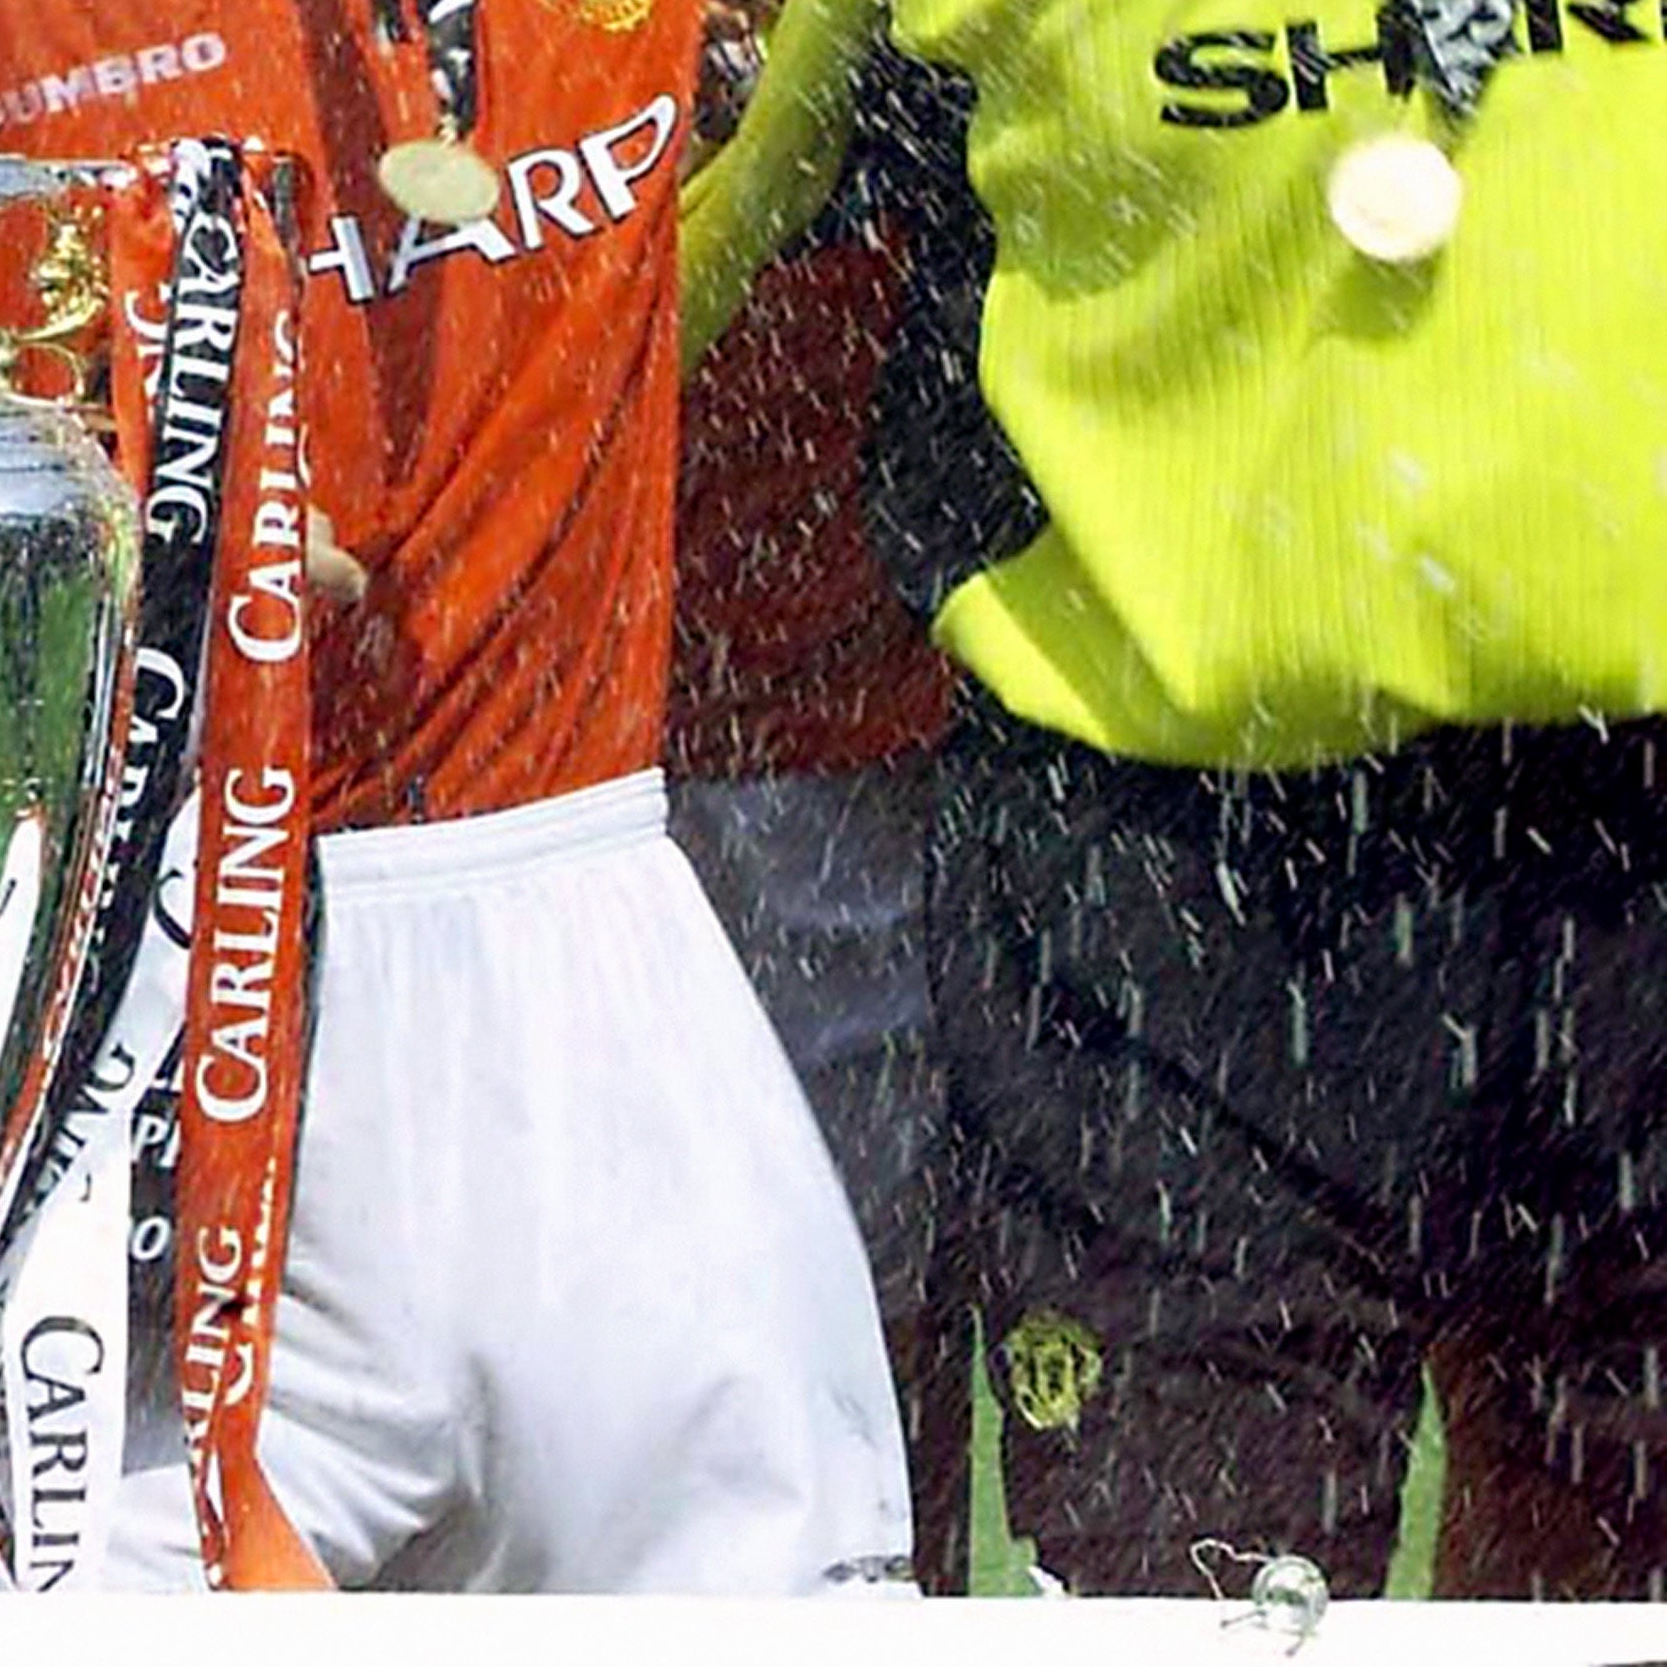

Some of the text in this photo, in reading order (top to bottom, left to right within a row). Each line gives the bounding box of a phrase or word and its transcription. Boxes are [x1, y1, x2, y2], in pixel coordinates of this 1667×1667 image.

[6, 30, 229, 126] UMBRO
[145, 216, 246, 544] CARLING
[194, 765, 297, 1122] CARLING
